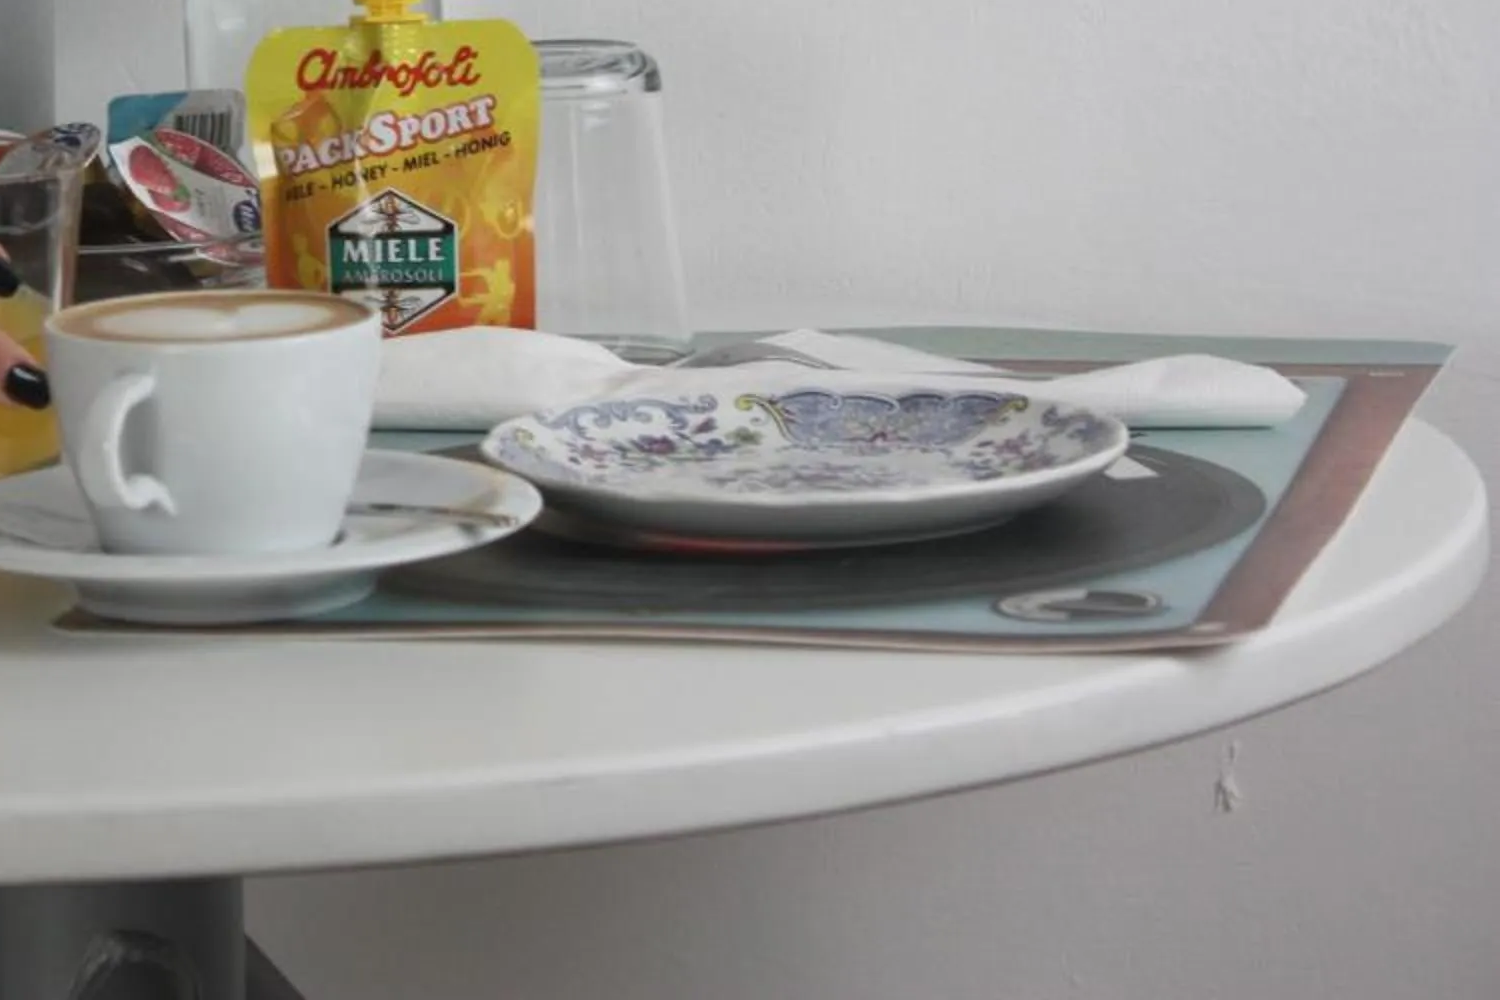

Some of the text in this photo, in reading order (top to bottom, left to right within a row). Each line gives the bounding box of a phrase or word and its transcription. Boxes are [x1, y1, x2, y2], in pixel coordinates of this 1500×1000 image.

[402, 151, 439, 173] MIEL
[455, 131, 512, 158] HONIG
[343, 237, 445, 263] MIELE
